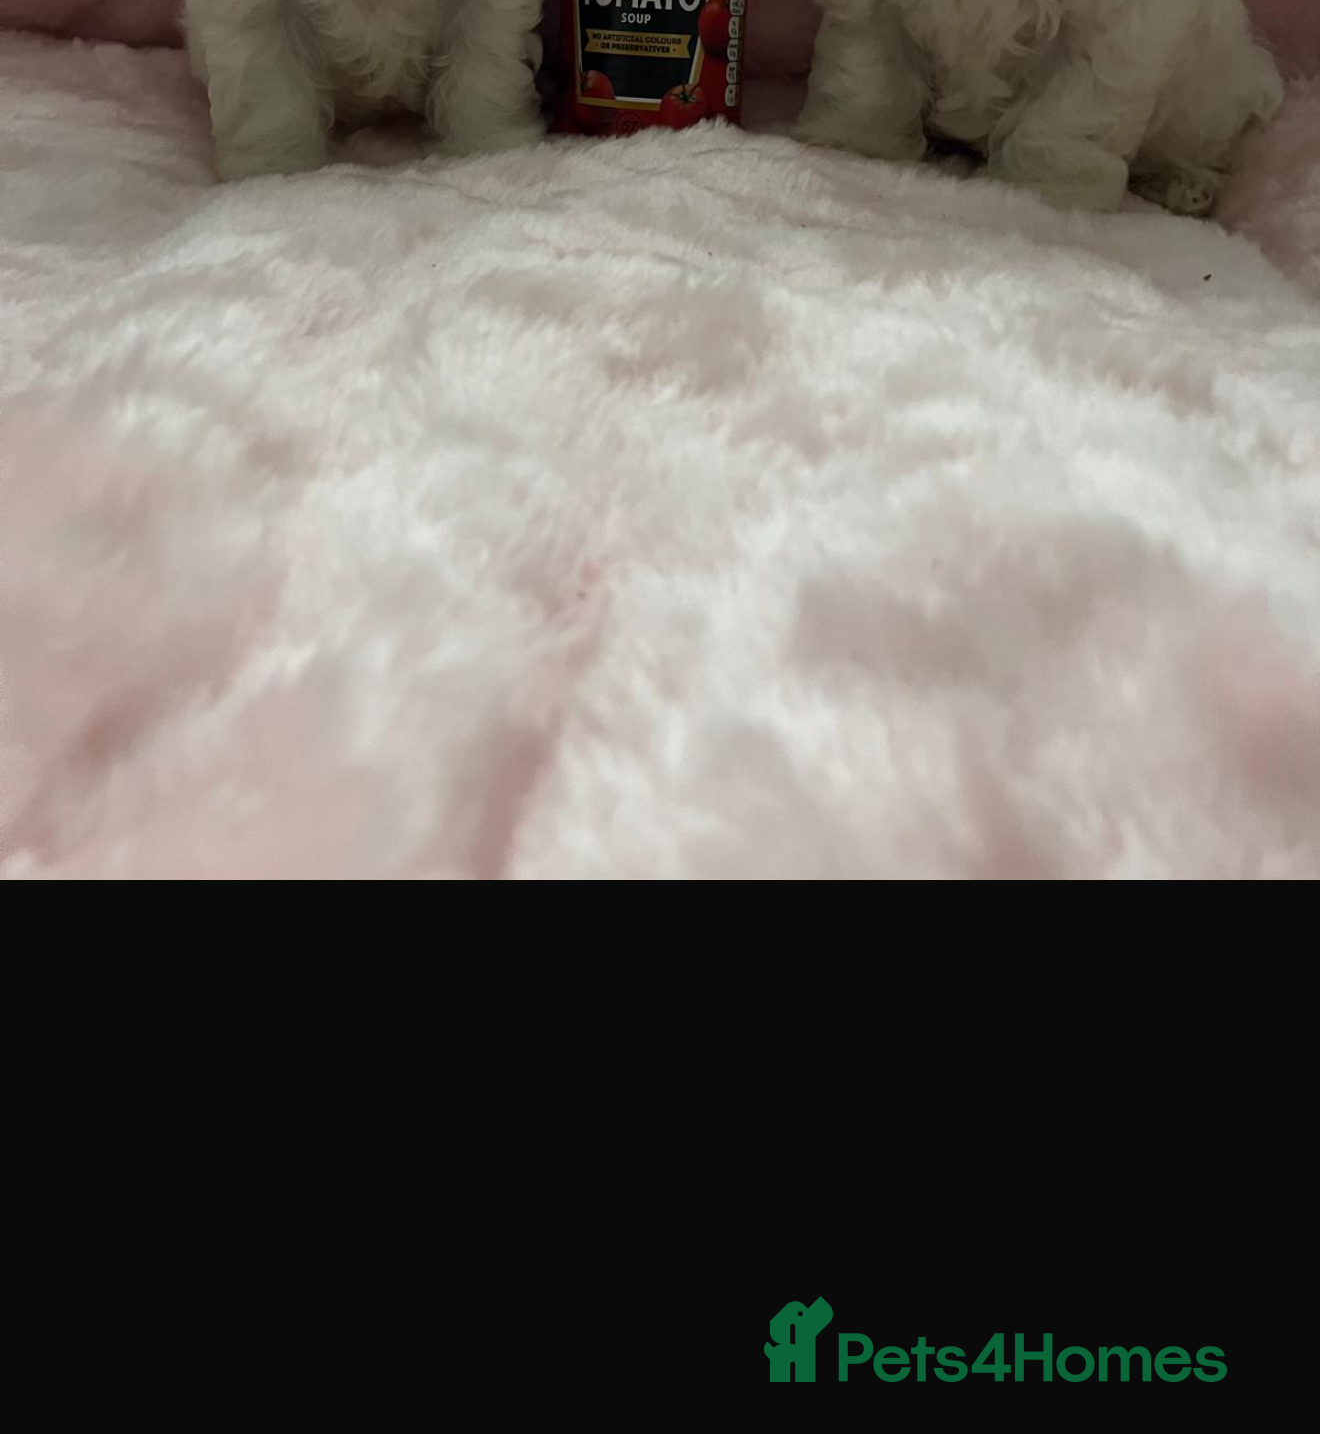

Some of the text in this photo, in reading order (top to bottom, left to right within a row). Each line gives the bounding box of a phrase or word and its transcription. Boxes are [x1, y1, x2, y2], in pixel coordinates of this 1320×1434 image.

[621, 12, 651, 24] SOUP
[592, 32, 682, 45] NO ARTIFICIAL COLOURS
[600, 42, 671, 54] OR PRESERVATIVES
[620, 121, 639, 135] 57
